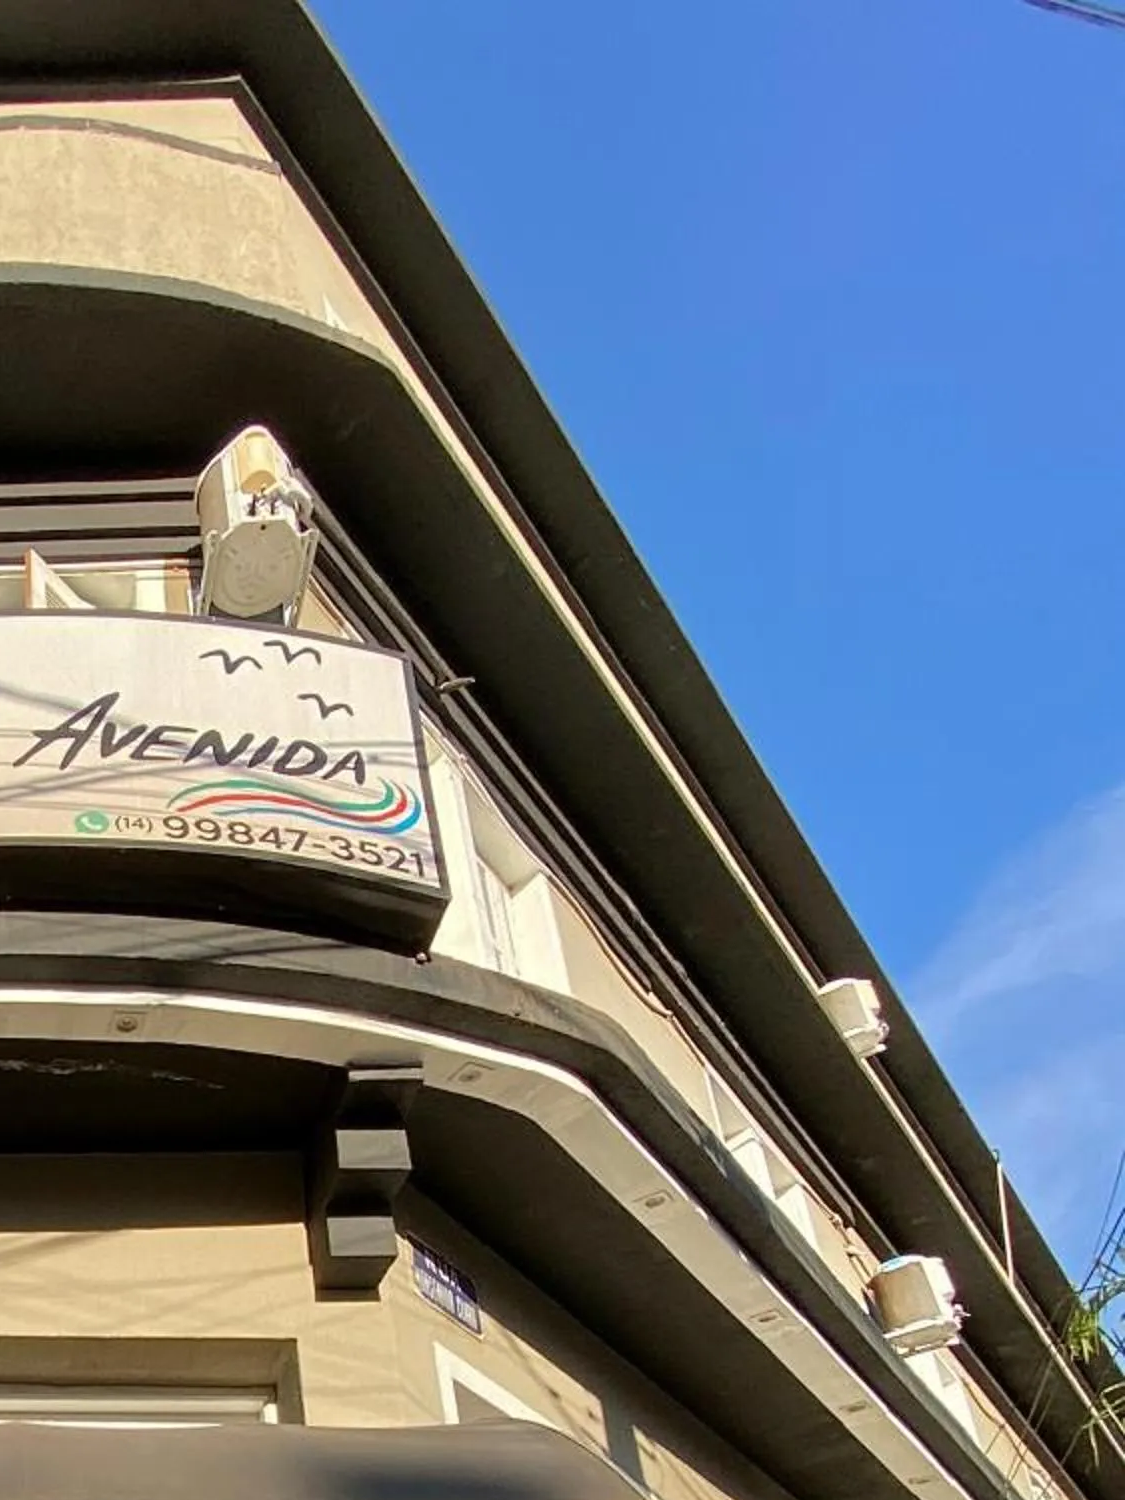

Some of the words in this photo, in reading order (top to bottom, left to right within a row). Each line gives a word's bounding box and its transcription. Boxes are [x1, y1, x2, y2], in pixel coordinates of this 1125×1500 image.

[13, 691, 366, 785] AVENIDA
[114, 815, 153, 833] (14)
[162, 815, 425, 877] 99847-3521
